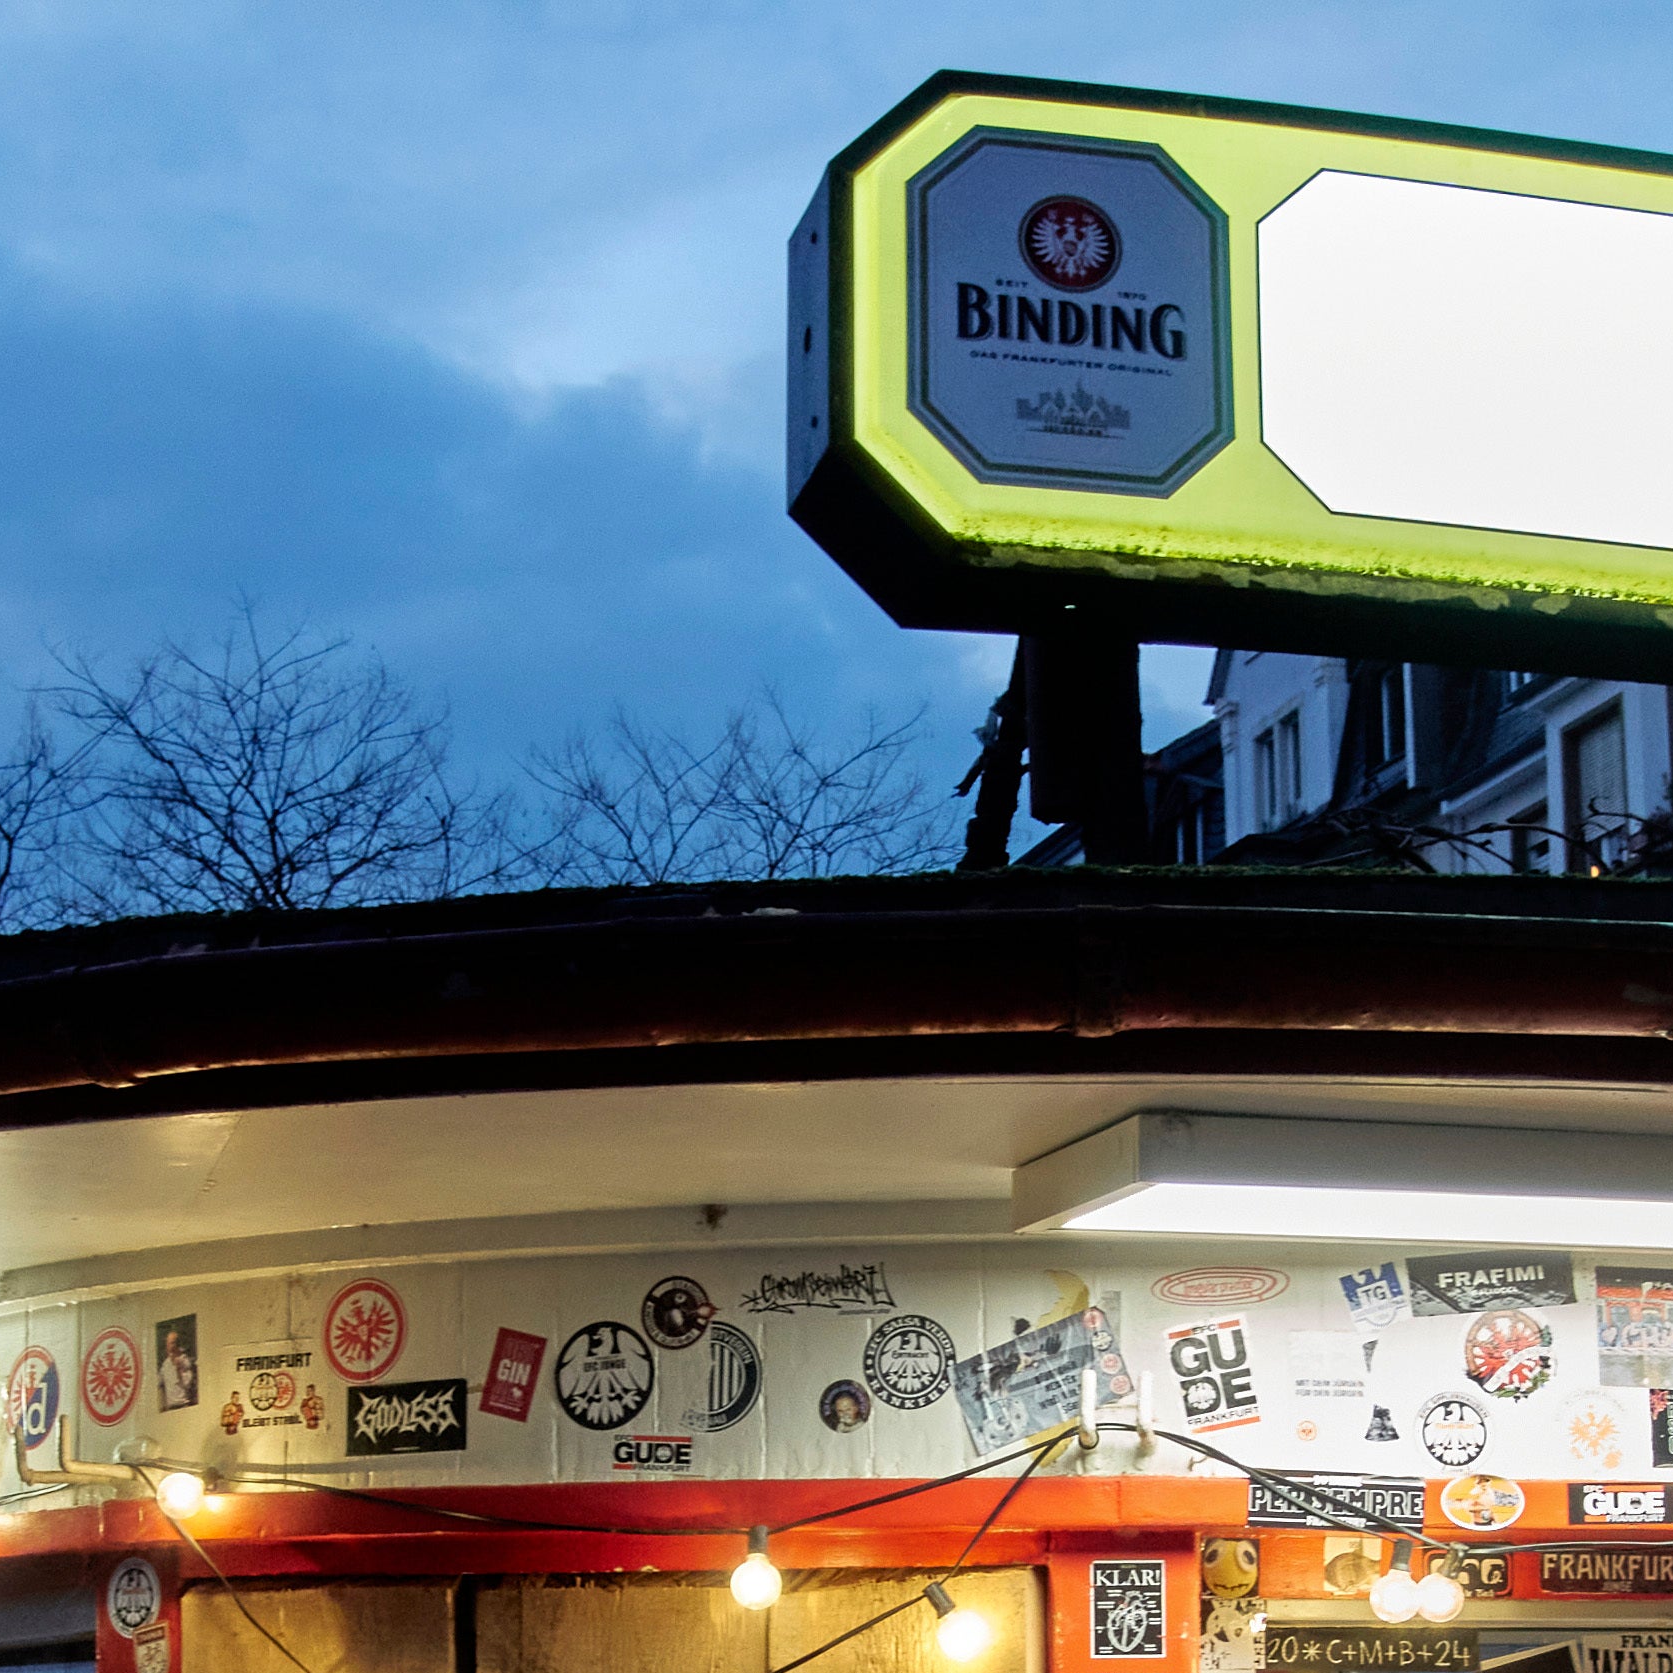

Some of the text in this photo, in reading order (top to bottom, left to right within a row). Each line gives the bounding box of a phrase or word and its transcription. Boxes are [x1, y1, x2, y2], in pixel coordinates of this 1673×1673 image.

[956, 281, 1187, 360] BINDING
[970, 349, 1173, 377] DAS FRANKFURTER ORIGINAL
[1192, 1324, 1216, 1337] EFC
[236, 1352, 312, 1372] FRANKFURT
[495, 1359, 531, 1386] GIN
[1187, 1406, 1260, 1427] FRANKFURT
[614, 1441, 692, 1465] GUDE
[633, 1464, 691, 1473] FRANKFURT
[1583, 1491, 1666, 1516] GUDE
[1605, 1513, 1665, 1523] FRANKFURT
[1095, 1569, 1161, 1587] KLAR!
